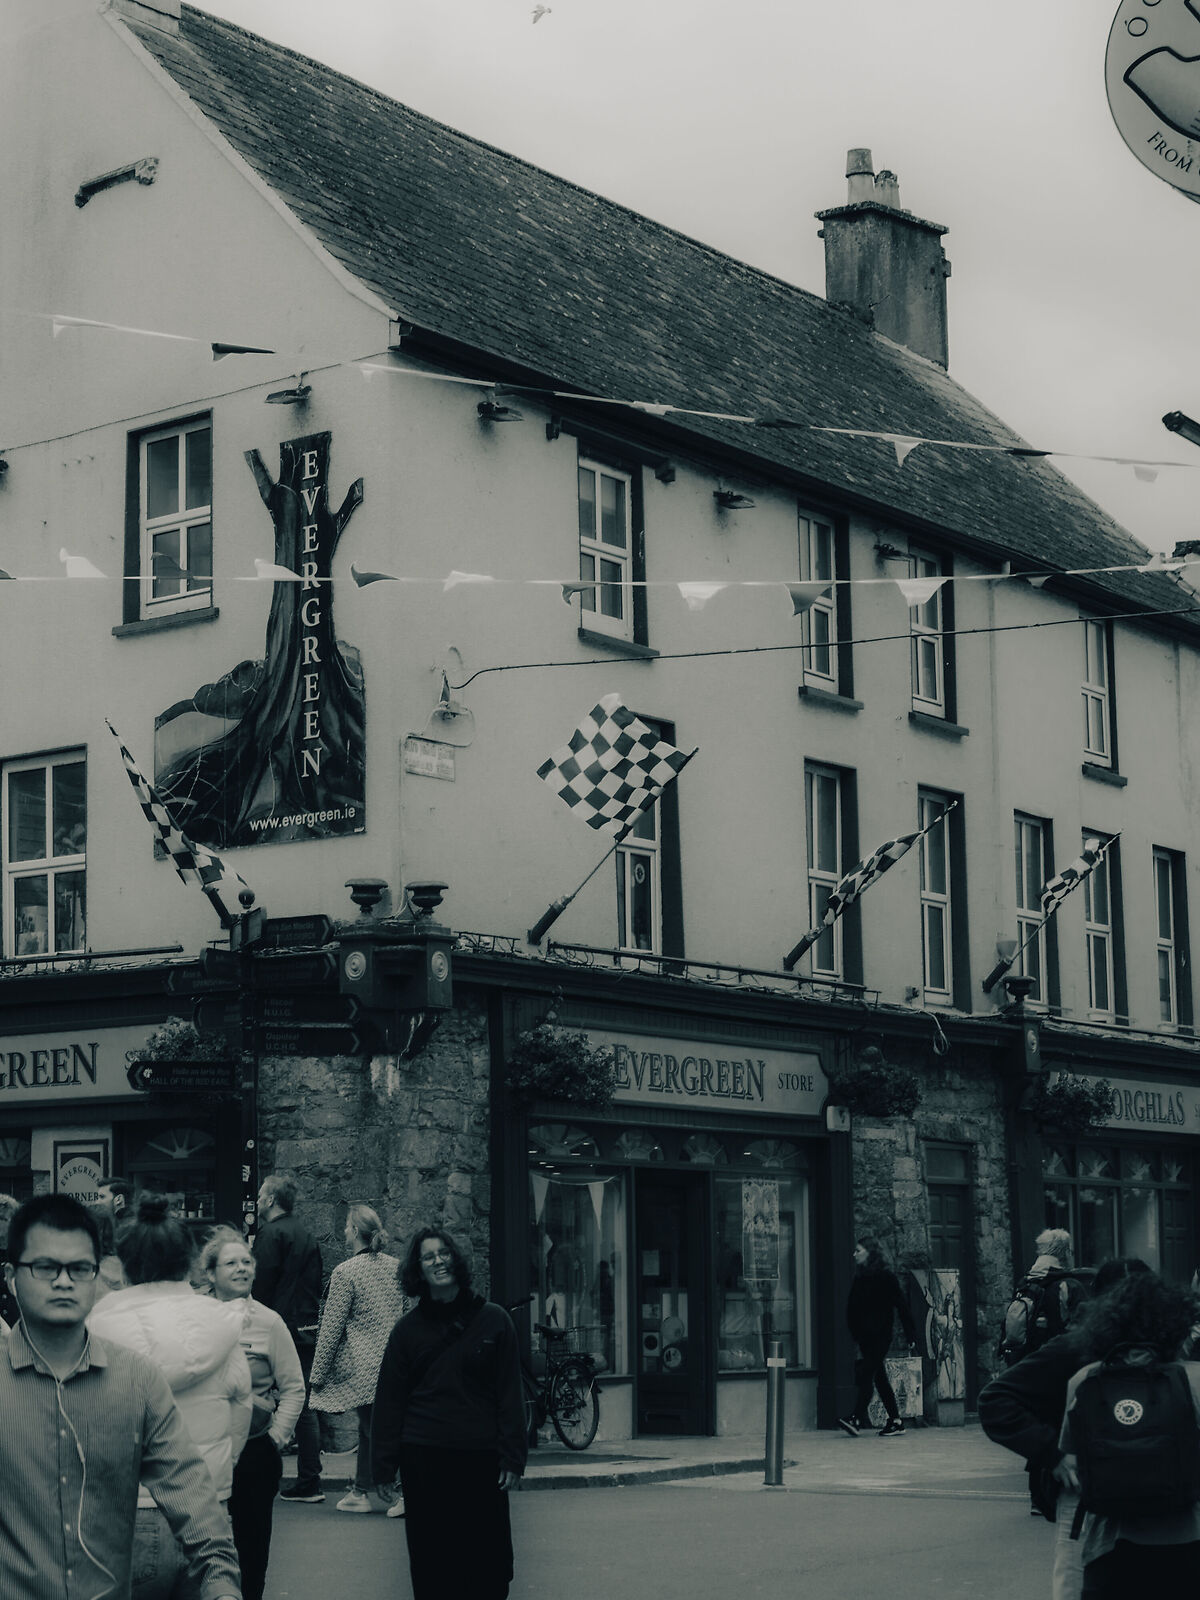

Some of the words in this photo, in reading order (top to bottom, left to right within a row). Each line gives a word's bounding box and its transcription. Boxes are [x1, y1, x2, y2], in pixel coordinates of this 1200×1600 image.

[1147, 131, 1193, 172] FROM
[301, 449, 322, 779] EVERGREEN
[249, 803, 356, 831] www.evergreen.ie
[612, 1043, 766, 1102] EVERGREEN
[777, 1072, 815, 1093] STORE
[1110, 1086, 1186, 1127] ORGHLAS
[66, 1191, 99, 1203] ORNER
